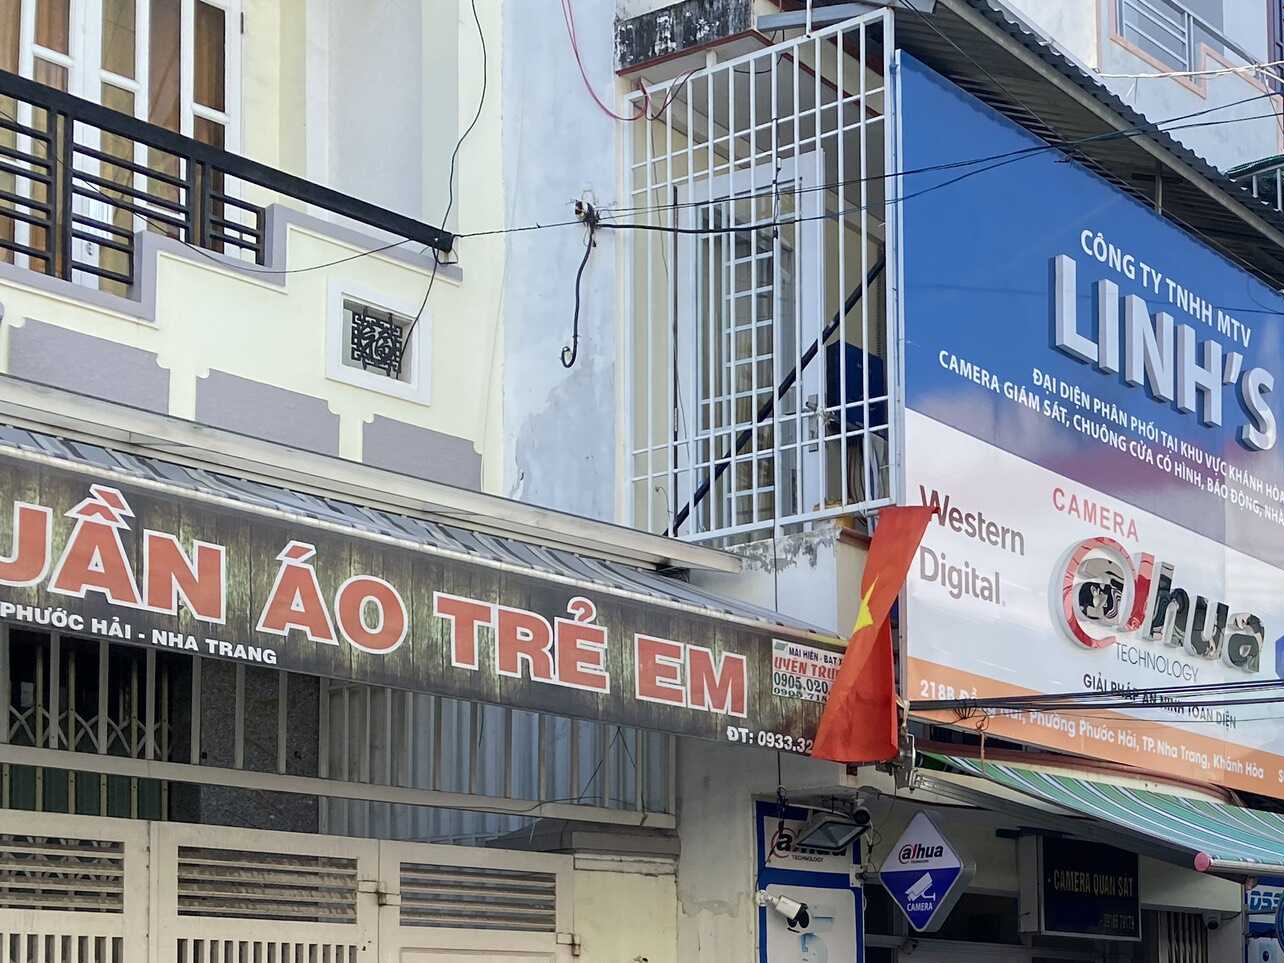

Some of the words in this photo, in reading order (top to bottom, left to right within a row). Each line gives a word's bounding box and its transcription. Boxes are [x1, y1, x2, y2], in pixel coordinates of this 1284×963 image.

[1080, 229, 1136, 280] CÔNG
[1139, 261, 1163, 295] TY
[1165, 277, 1213, 327] TNHH
[1217, 309, 1252, 348] MTV
[1051, 253, 1277, 451] LINH'S
[938, 350, 1001, 393] CAMERA
[1003, 380, 1041, 413] GIÁM
[1042, 400, 1071, 428] SÁT,
[1073, 414, 1127, 453] CHUÔNG
[1129, 437, 1154, 465] CỬA
[1156, 452, 1172, 473] CÓ
[1174, 461, 1205, 491] HÌNH,
[1207, 475, 1229, 500] BÁO
[1230, 490, 1263, 518] ĐỘNG,
[1033, 367, 1057, 395] ĐẠI
[1060, 380, 1091, 411] DIỆN
[1093, 397, 1128, 429] PHÂN
[1130, 416, 1159, 443] PHỐI
[1161, 431, 1179, 455] TẠI
[1181, 438, 1203, 464] KHU
[1205, 452, 1228, 476] VỰC
[1228, 463, 1264, 493] KHÁNH
[919, 484, 1025, 557] Western
[1052, 486, 1140, 543] CAMERA
[0, 603, 84, 631] PHƯỚC
[91, 616, 131, 640] HẢI
[152, 629, 200, 652] NHA
[205, 638, 278, 665] TRANG
[256, 540, 408, 655] ÁO
[432, 590, 611, 694] TRẺ
[634, 632, 747, 719] EM
[1115, 641, 1200, 683] TECHNOLOGY
[773, 671, 831, 695] 0905.020.
[1083, 671, 1108, 693] GIẢI
[1216, 711, 1237, 731] DIỆN
[726, 725, 754, 744] ĐT:
[757, 730, 814, 754] 0933.32
[920, 679, 955, 701] 218B
[1029, 710, 1076, 737] Phường
[1079, 719, 1115, 743] Phước
[1117, 727, 1140, 752] Hải,
[1180, 744, 1211, 769] Trang,
[1213, 753, 1244, 774] Khánh
[906, 902, 934, 912] CAMERA
